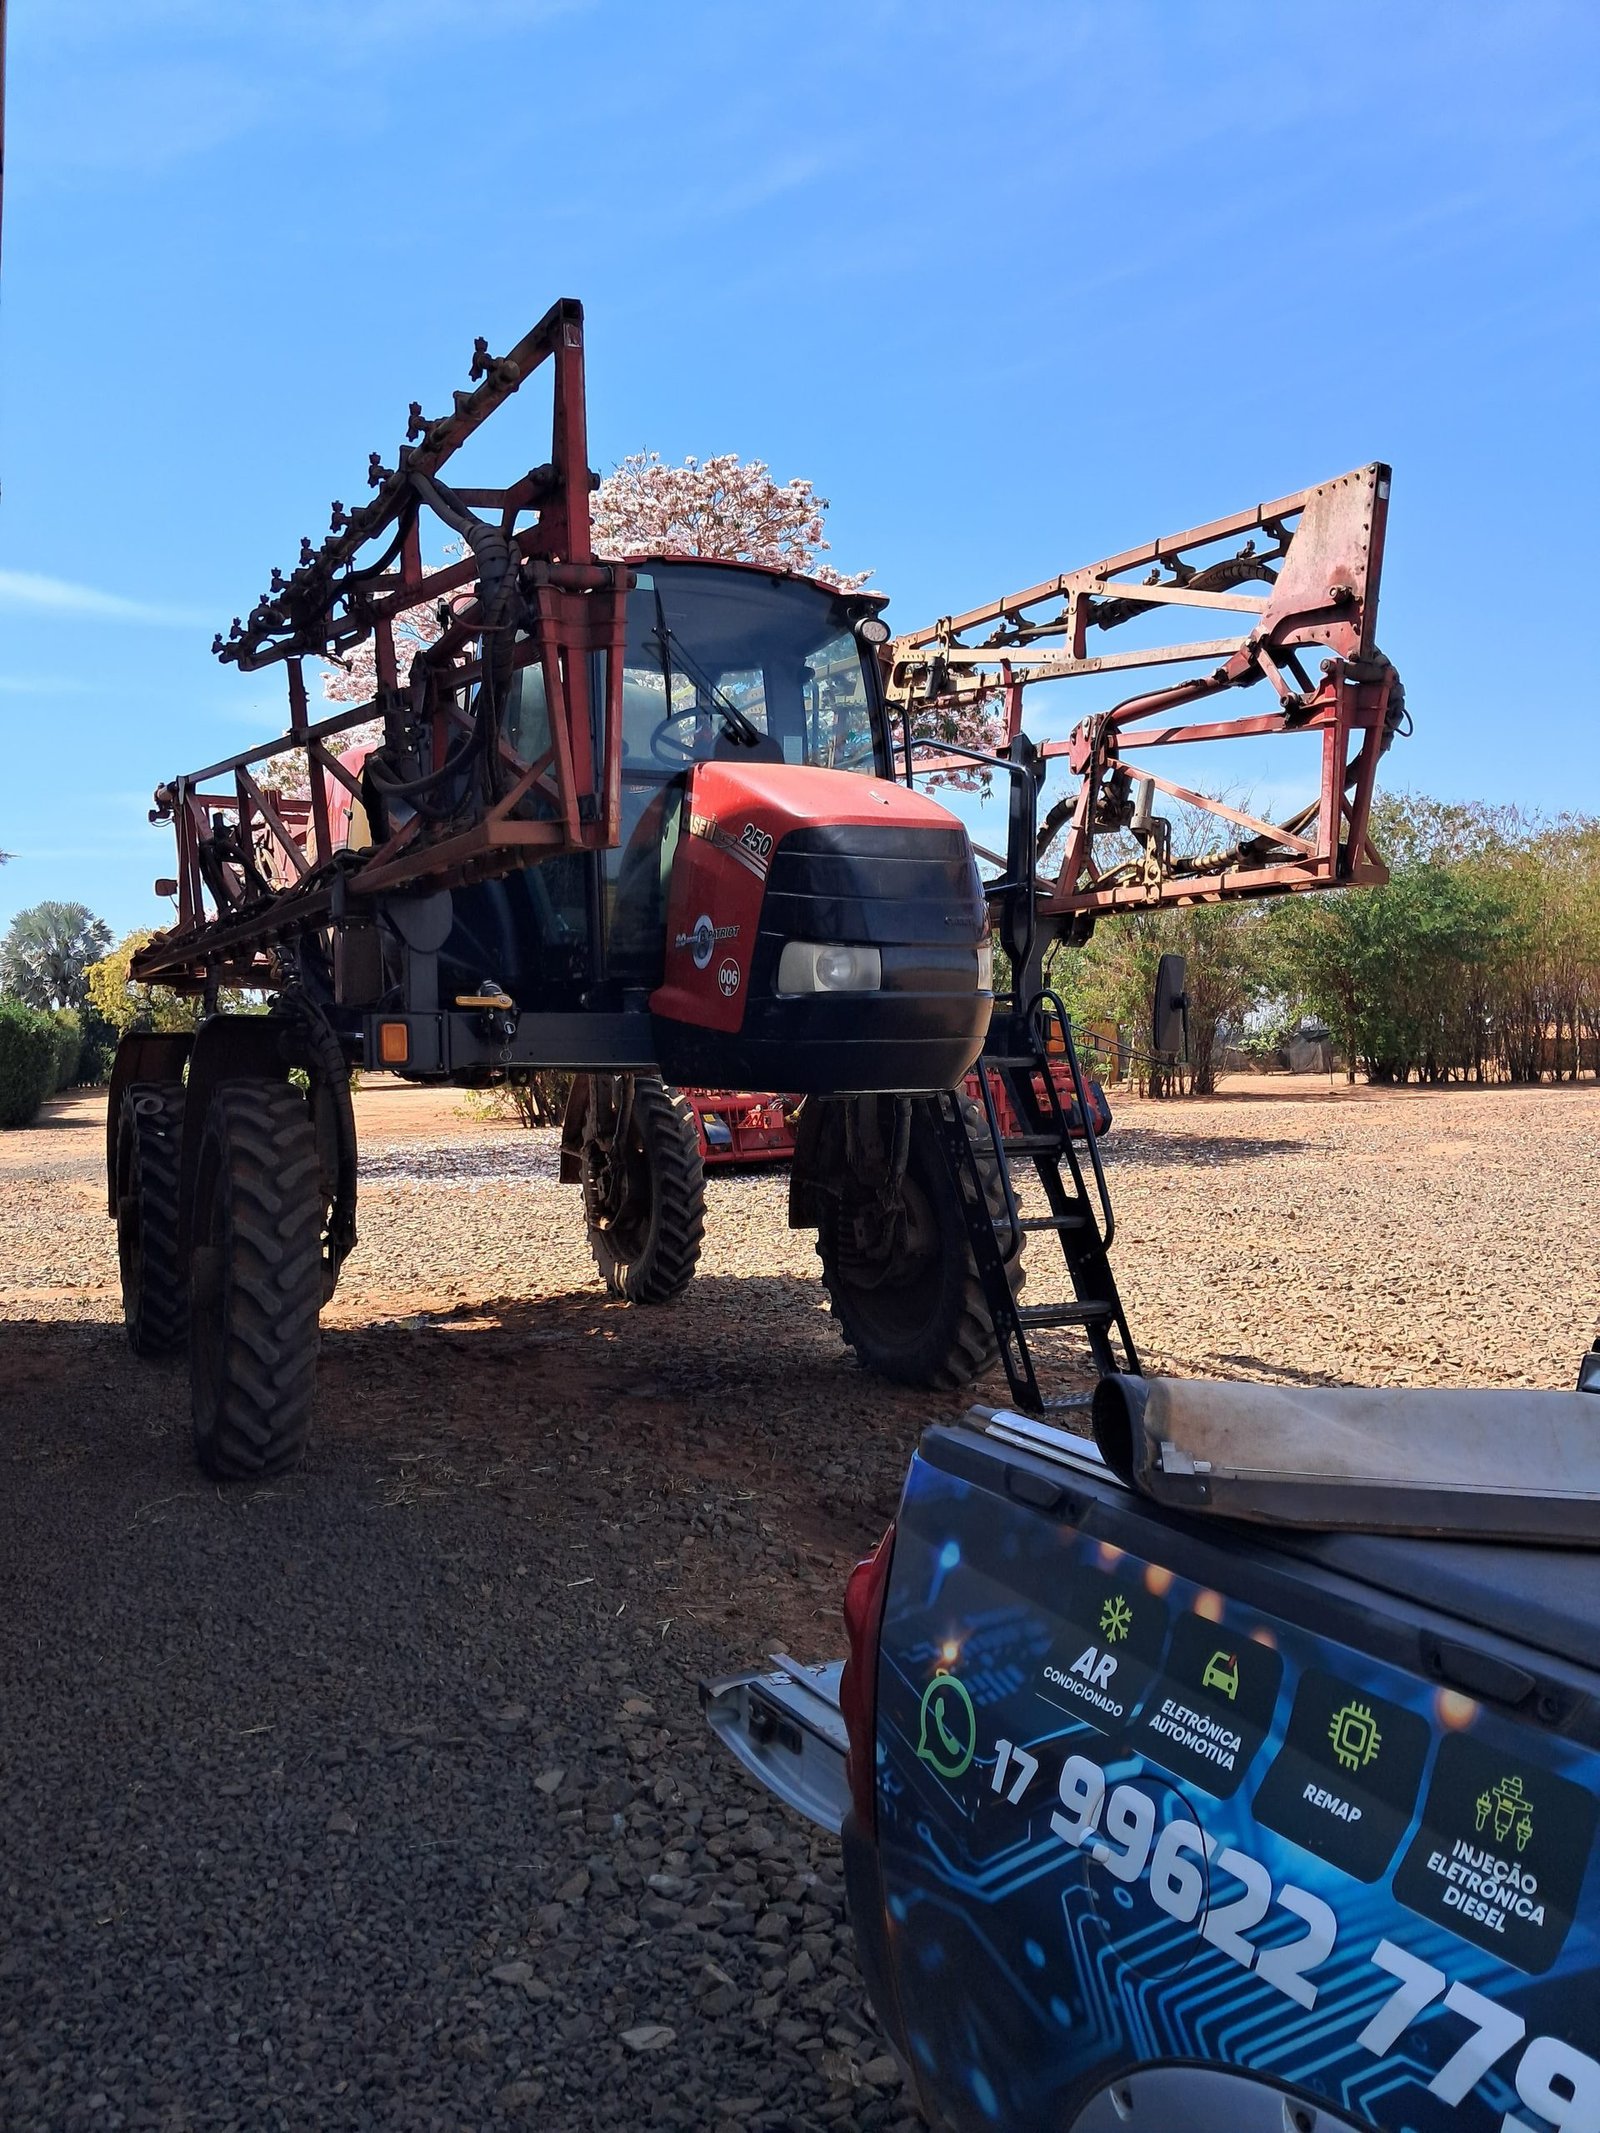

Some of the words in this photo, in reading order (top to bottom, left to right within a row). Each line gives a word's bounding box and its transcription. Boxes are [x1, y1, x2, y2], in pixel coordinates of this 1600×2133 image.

[740, 822, 774, 857] 250
[708, 925, 740, 940] PATRIOT
[720, 969, 738, 986] 006
[1043, 1666, 1123, 1718] CONDICIONADO
[1069, 1646, 1118, 1690] AR
[1148, 1714, 1236, 1772] AUTOMOTIVA
[1160, 1698, 1242, 1752] ELETRÔNICA
[991, 1738, 1039, 1805] 17
[1302, 1783, 1363, 1823] REMAP
[1426, 1851, 1546, 1927] ELETRÔNICA
[1451, 1839, 1538, 1895] INJEÇÃO
[1442, 1886, 1506, 1934] DIESEL
